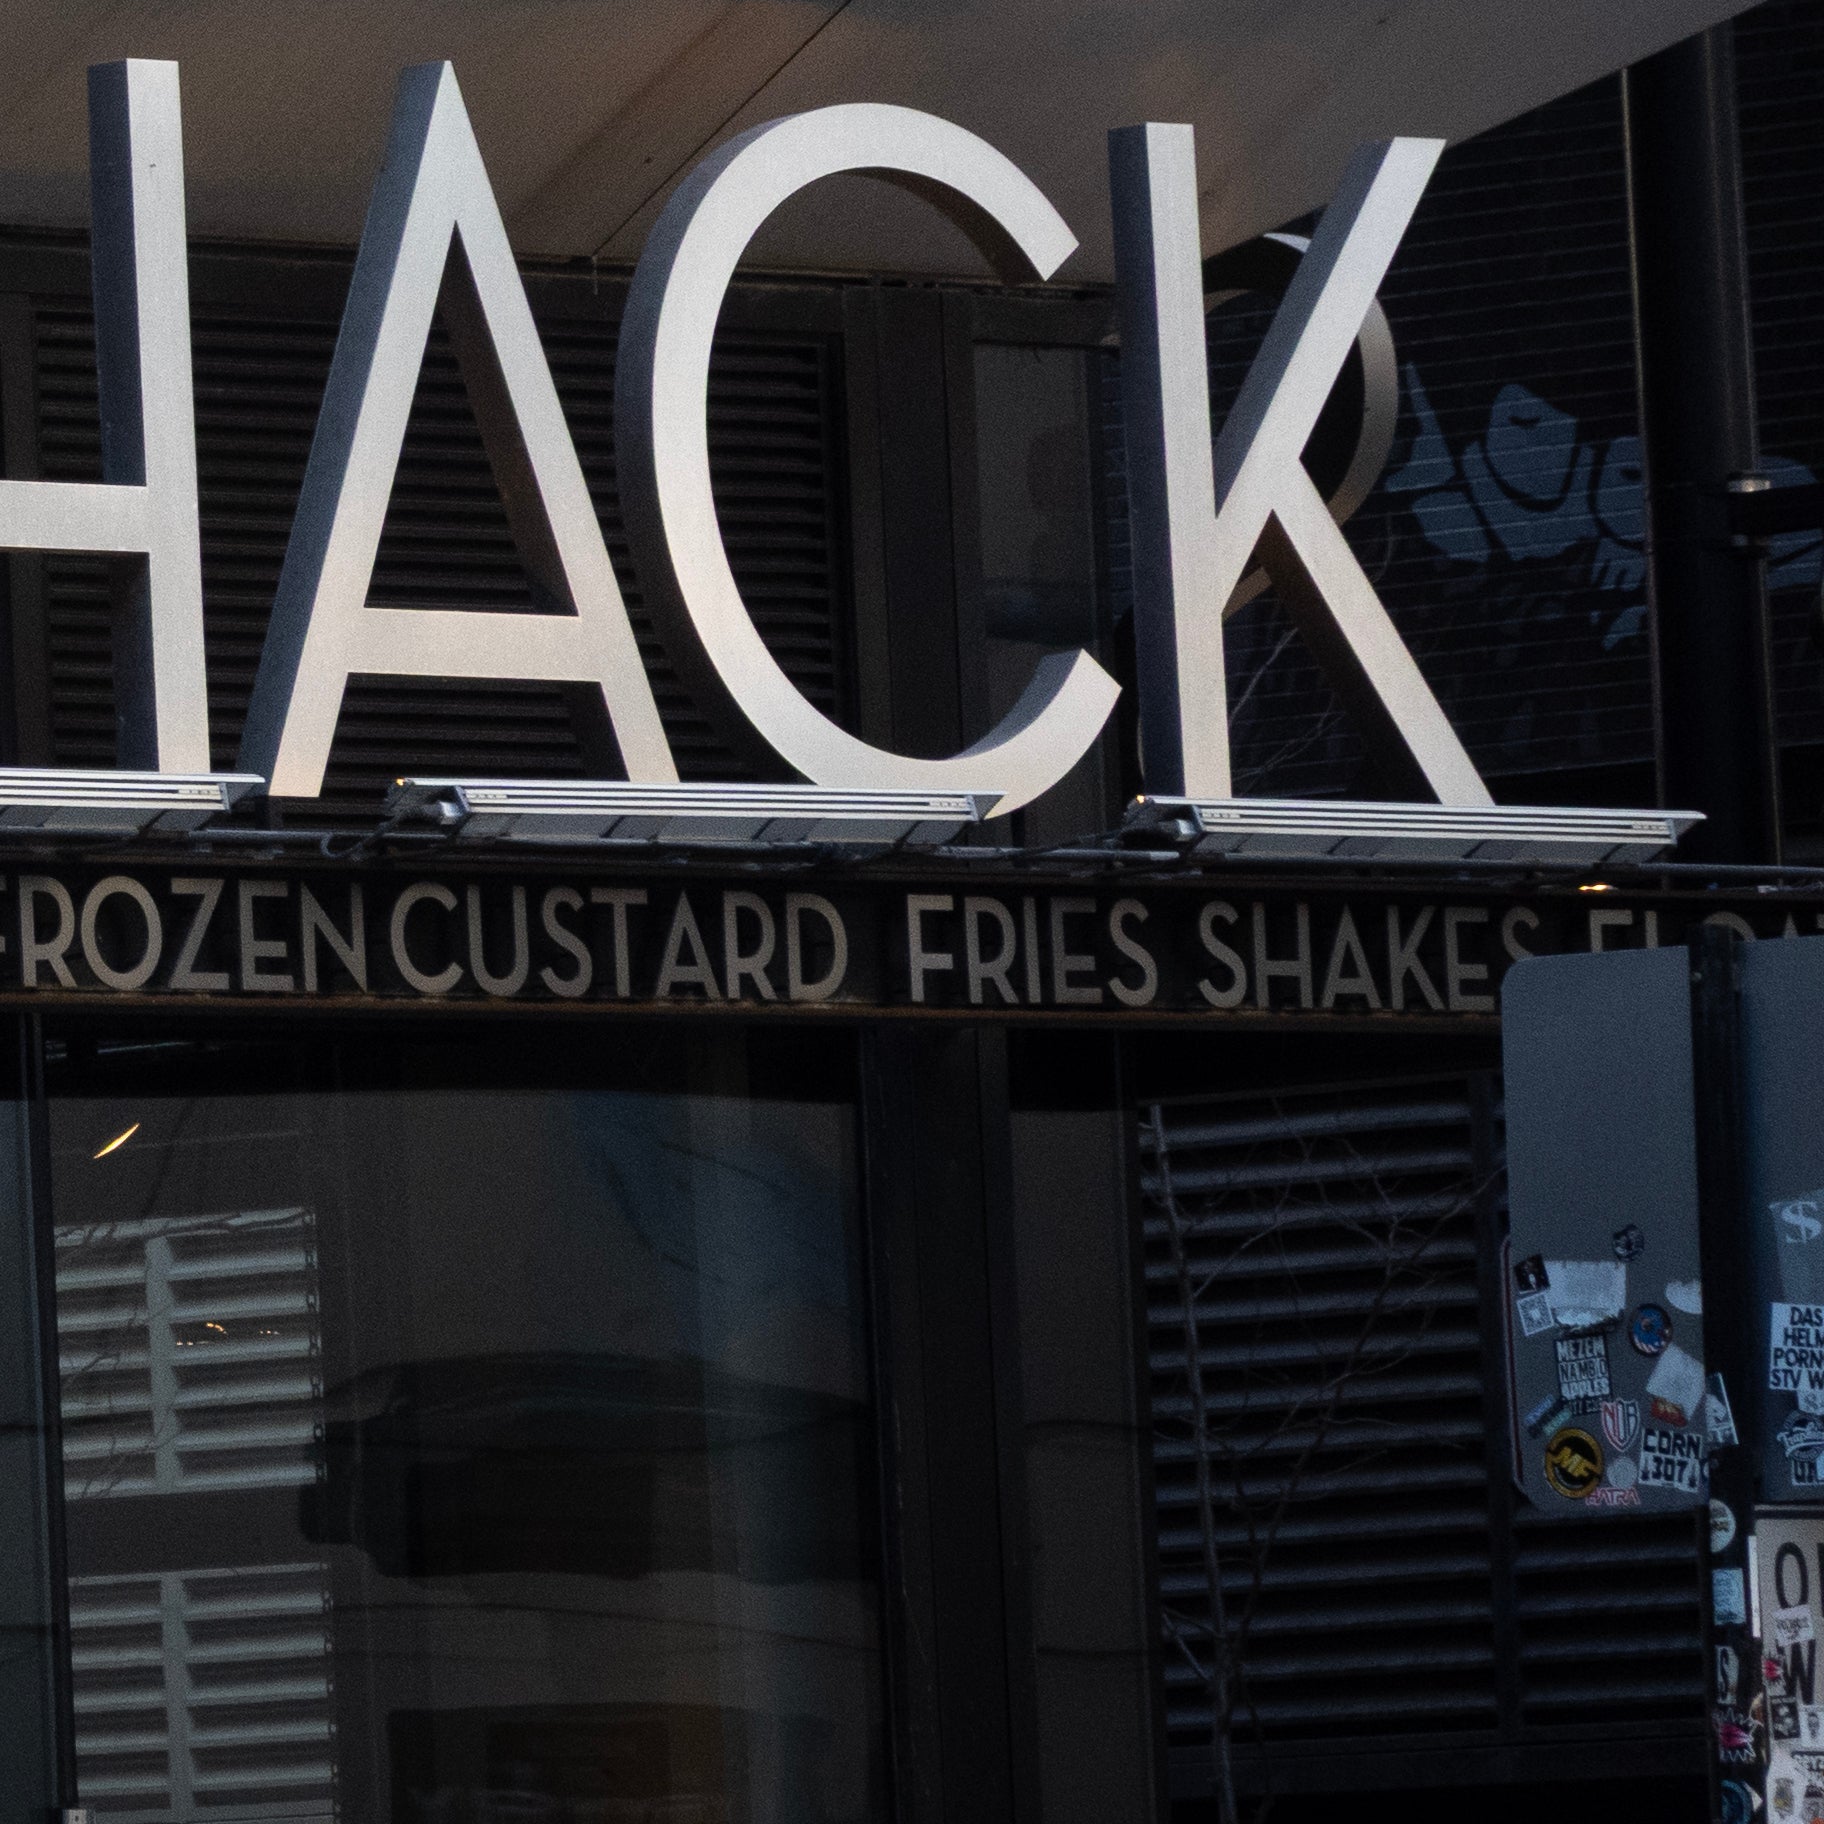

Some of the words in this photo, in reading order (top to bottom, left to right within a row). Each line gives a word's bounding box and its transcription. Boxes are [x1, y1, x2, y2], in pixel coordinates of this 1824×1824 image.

[388, 882, 850, 1004] CUSTARD
[905, 893, 1159, 1009] FRIES
[1643, 1428, 1701, 1459] CORN
